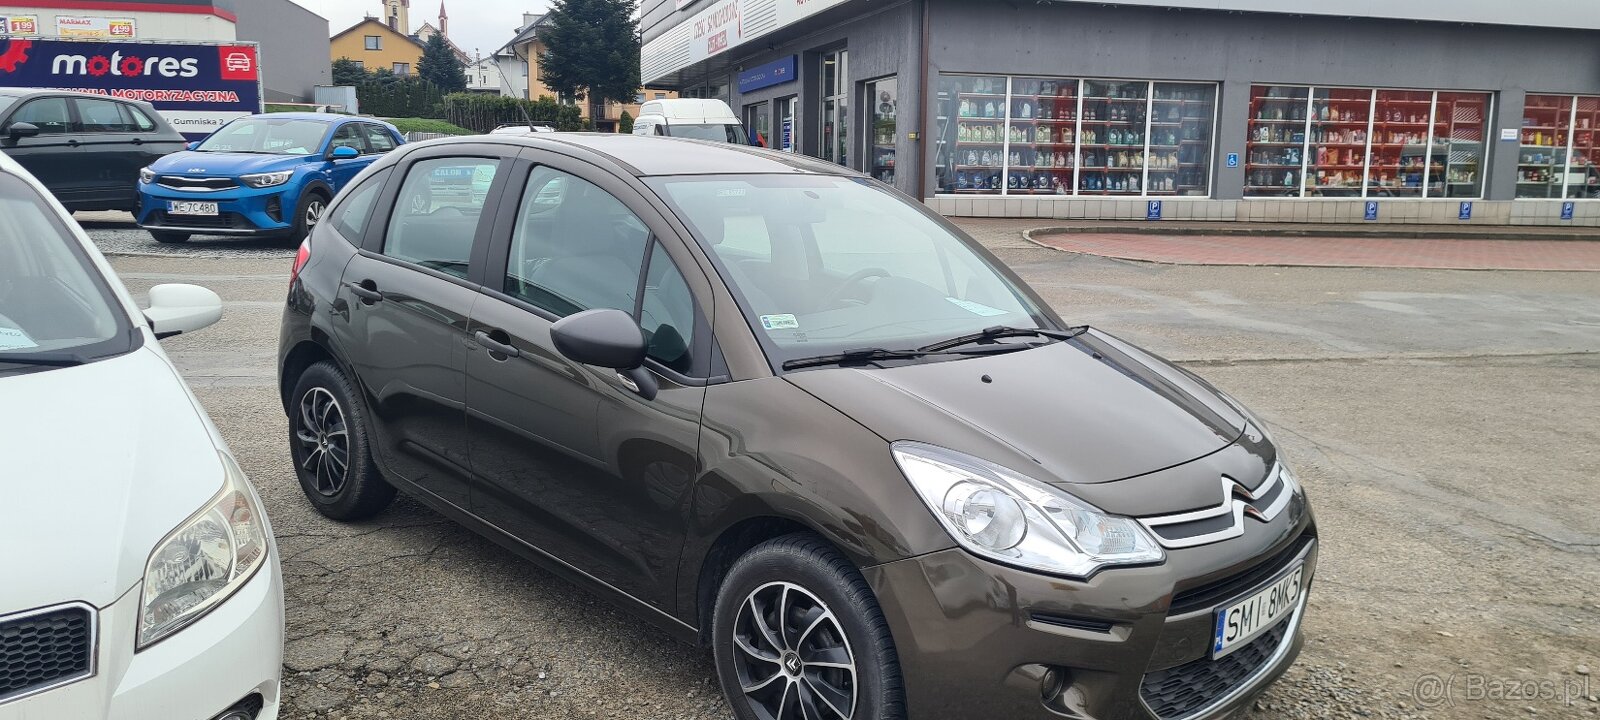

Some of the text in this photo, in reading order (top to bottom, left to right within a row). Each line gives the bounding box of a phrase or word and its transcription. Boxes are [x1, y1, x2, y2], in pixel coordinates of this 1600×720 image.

[52, 50, 198, 78] motores
[111, 89, 240, 102] MOTORYZACYJNA
[174, 202, 216, 213] WE 7C480
[1227, 569, 1301, 642] SMI 8MK5
